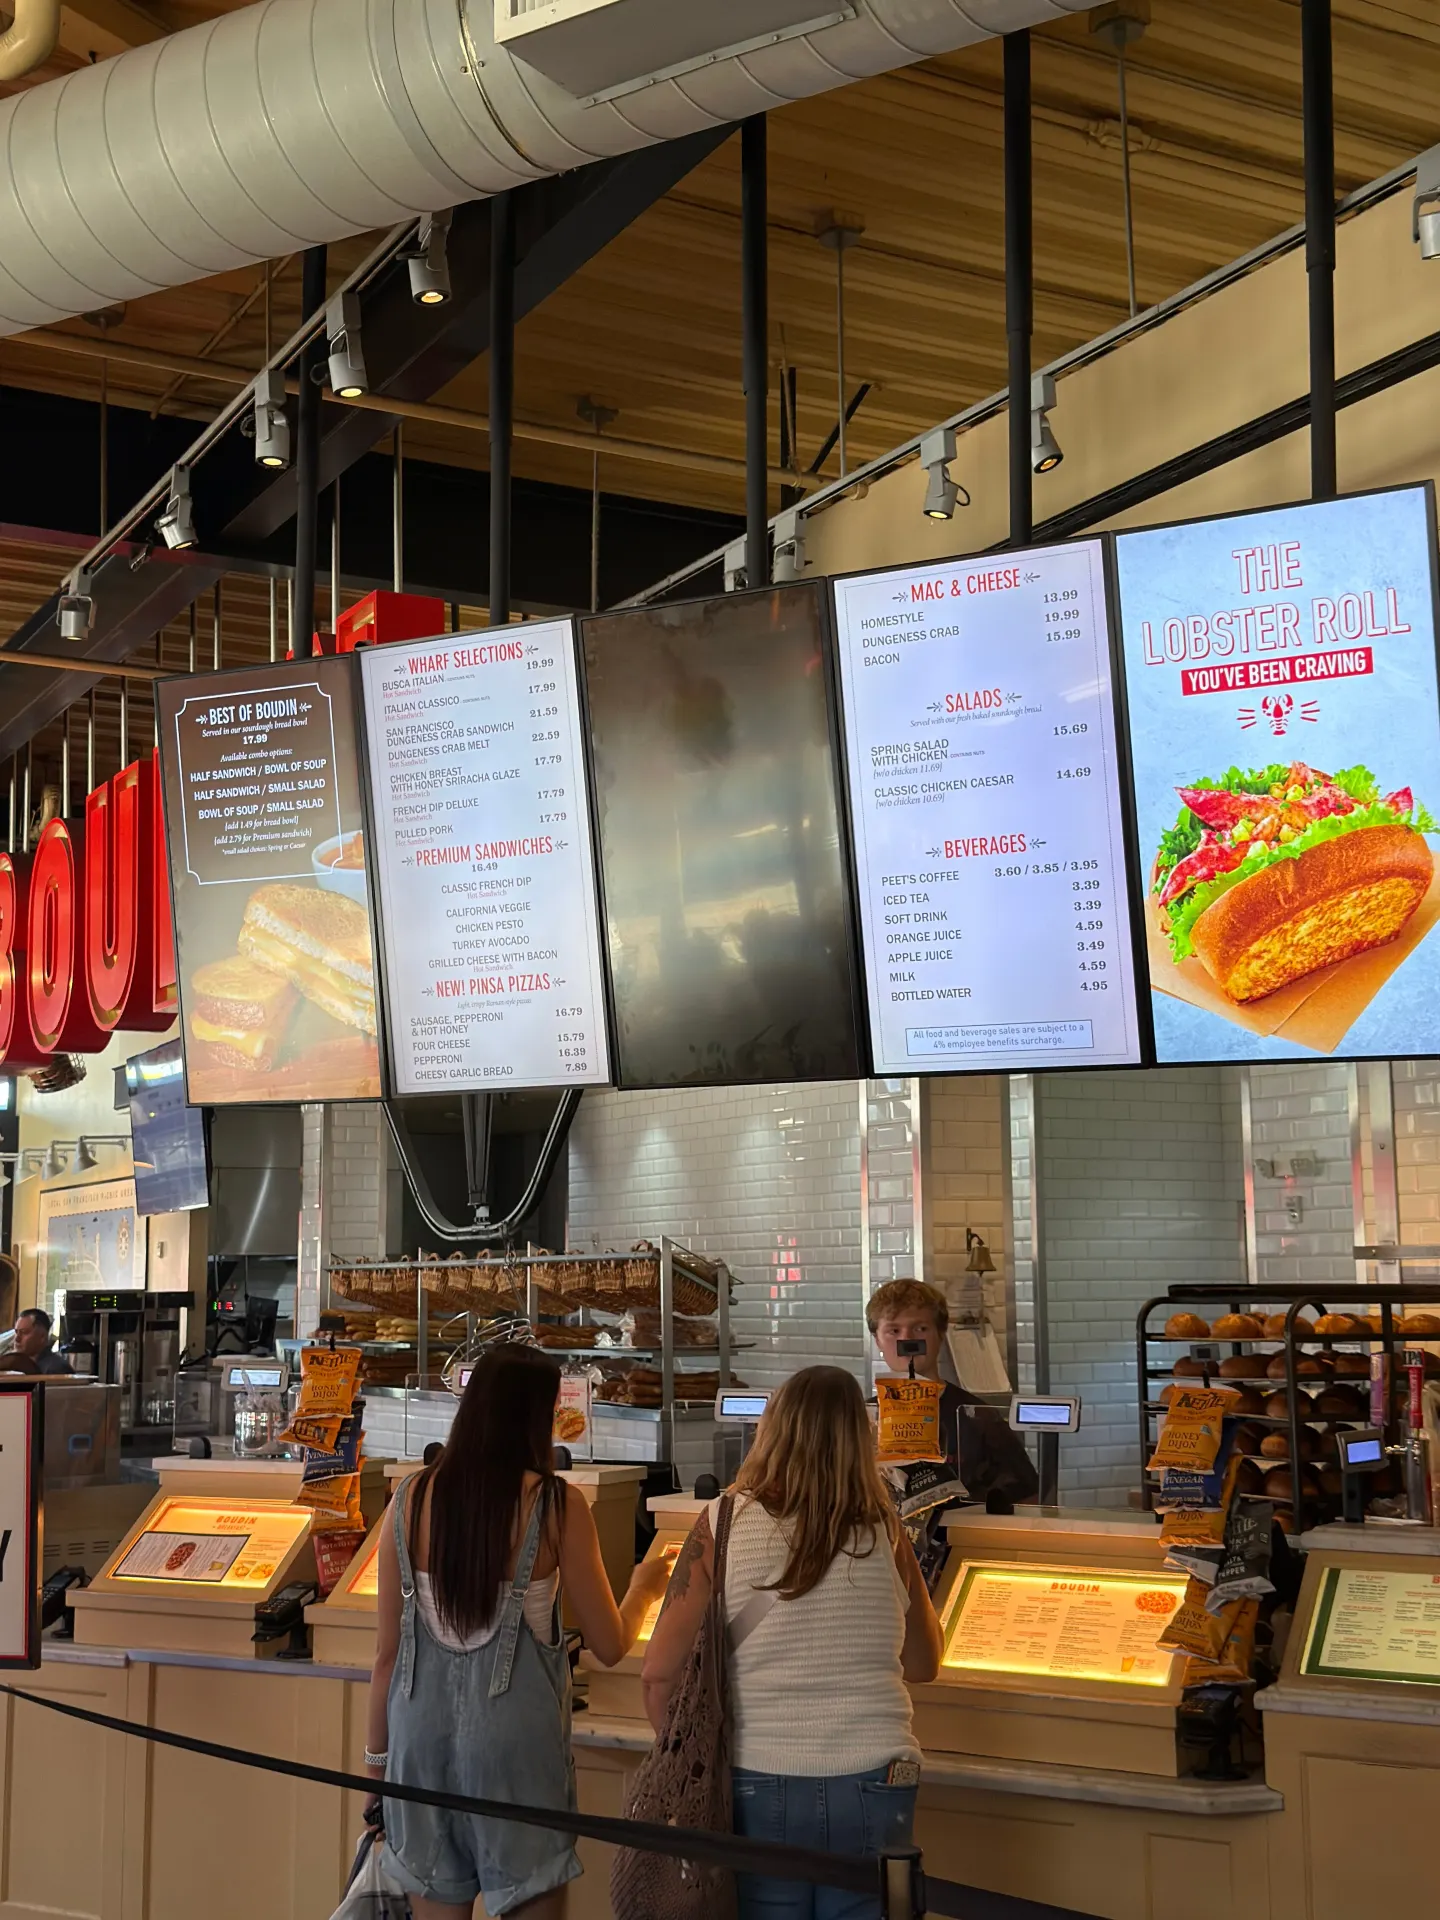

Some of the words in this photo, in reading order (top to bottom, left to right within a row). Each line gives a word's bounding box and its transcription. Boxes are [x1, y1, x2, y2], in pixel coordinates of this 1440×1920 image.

[1232, 541, 1302, 594] THE
[911, 580, 944, 602] MAC
[950, 579, 961, 597] &
[967, 569, 1020, 594] CHEESE
[1044, 590, 1078, 603] 13.99
[861, 611, 924, 629] HOMESTYLE
[1045, 609, 1079, 622] 19.99
[1142, 603, 1302, 664] LOBSTER
[1312, 588, 1411, 643] ROLL
[862, 630, 927, 648] DUNGENESS
[929, 625, 960, 638] CRAB
[1047, 629, 1081, 642] 15.99
[408, 653, 448, 674] WHARF
[454, 642, 523, 668] SELECTIONS
[527, 658, 554, 670] 19.99
[864, 653, 900, 666] BACON
[1188, 666, 1245, 691] YOU'VE
[1248, 660, 1290, 684] BEEN
[1295, 651, 1366, 679] CRAVING
[382, 679, 410, 691] BUSCA
[412, 674, 444, 686] ITALIAN
[529, 682, 556, 694] 17.99
[384, 702, 416, 714] ITALIAN
[417, 696, 460, 709] CLASSICO
[945, 689, 1002, 712] SALADS
[209, 706, 235, 725] BEST
[238, 704, 252, 722] OF
[256, 700, 297, 719] BOUDIN
[529, 706, 558, 718] 21.59
[202, 727, 222, 737] Served
[242, 722, 273, 732] sourdough
[274, 719, 292, 729] bread
[292, 717, 308, 727] bowl
[386, 727, 404, 738] SAN
[405, 720, 454, 736] FRANCISCO
[1054, 723, 1088, 736] 15.69
[243, 734, 268, 744] 17.99
[386, 732, 438, 747] DUNGENESS
[440, 728, 464, 740] CRAB
[466, 722, 514, 736] SANDWICH
[871, 743, 911, 756] SPRING
[913, 738, 949, 752] SALAD
[535, 754, 562, 766] 17.79
[871, 755, 899, 766] WITH
[901, 750, 948, 763] CHICKEN
[190, 771, 210, 782] HALF
[212, 767, 256, 779] SANDWICH
[264, 763, 289, 774] BOWL
[290, 761, 302, 772] OF
[303, 758, 326, 770] SOUP
[390, 771, 427, 784] CHICKEN
[429, 766, 462, 779] BREAST
[1057, 767, 1091, 779] 14.69
[390, 782, 413, 793] WITH
[414, 778, 444, 790] HONEY
[445, 773, 490, 786] SRIRACHA
[492, 769, 520, 780] GLAZE
[874, 784, 918, 798] CLASSIC
[920, 780, 967, 793] CHICKEN
[970, 774, 1014, 788] CAESAR
[198, 808, 222, 819] BOWL
[223, 807, 234, 817] OF
[236, 804, 259, 815] SOUP
[266, 801, 295, 812] SMALL
[296, 798, 324, 810] SALAD
[416, 846, 470, 866] PREMIUM
[475, 836, 552, 860] SANDWICHES
[945, 834, 1026, 858] BEVERAGES
[472, 862, 498, 872] 16.49
[994, 866, 1021, 877] 3.60
[1032, 863, 1059, 874] 3.85
[1070, 860, 1098, 871] 3.95
[441, 882, 477, 894] CLASSIC
[479, 878, 514, 890] FRENCH
[516, 876, 532, 887] DIP
[881, 874, 916, 886] PEET'S
[919, 870, 959, 883] COFFEE
[1072, 880, 1100, 891] 3.39
[883, 894, 907, 905] ICED
[910, 893, 930, 903] TEA
[1074, 900, 1102, 911] 3.39
[446, 905, 497, 918] CALIFORNIA
[498, 901, 531, 913] VEGGIE
[884, 913, 910, 925] SOFT
[913, 911, 948, 922] DRINK
[455, 922, 493, 933] CHICKEN
[495, 919, 524, 930] PESTO
[1075, 920, 1103, 931] 4.59
[886, 931, 930, 944] ORANGE
[933, 929, 962, 941] JUICE
[1077, 940, 1105, 951] 3.49
[888, 952, 922, 963] APPLE
[924, 949, 953, 961] JUICE
[1078, 960, 1106, 971] 4.59
[889, 972, 915, 982] MILK
[436, 980, 465, 997] NEW!
[469, 977, 504, 995] PINSA
[508, 973, 550, 992] PIZZAS
[1080, 980, 1108, 991] 4.95
[891, 990, 934, 1001] BOTTLED
[936, 988, 971, 998] WATER
[555, 1007, 583, 1017] 16.79
[410, 1015, 452, 1028] SAUSAGE,
[454, 1012, 503, 1024] PEPPERONI
[411, 1027, 419, 1037] &
[420, 1026, 437, 1036] HOT
[439, 1024, 468, 1034] HONEY
[558, 1032, 585, 1042] 15.79
[925, 1030, 943, 1038] food
[944, 1029, 959, 1037] and
[960, 1029, 997, 1037] beverage
[998, 1026, 1020, 1035] sales
[1037, 1024, 1067, 1034] subject
[1068, 1024, 1078, 1032] to
[947, 1040, 985, 1049] employee
[986, 1037, 1019, 1046] benefits
[1020, 1036, 1065, 1046] surcharge.
[559, 1047, 586, 1057] 16.39
[414, 1054, 462, 1065] PEPPERONI
[415, 1070, 447, 1080] CHEESY
[449, 1068, 481, 1078] GARLIC
[483, 1066, 513, 1076] BREAD
[565, 1062, 587, 1072] 7.89
[1168, 1432, 1200, 1440] HONEY
[1168, 1440, 1197, 1449] DIJON
[911, 1474, 938, 1491] PEPPER
[1051, 1582, 1100, 1593] BOUDIN
